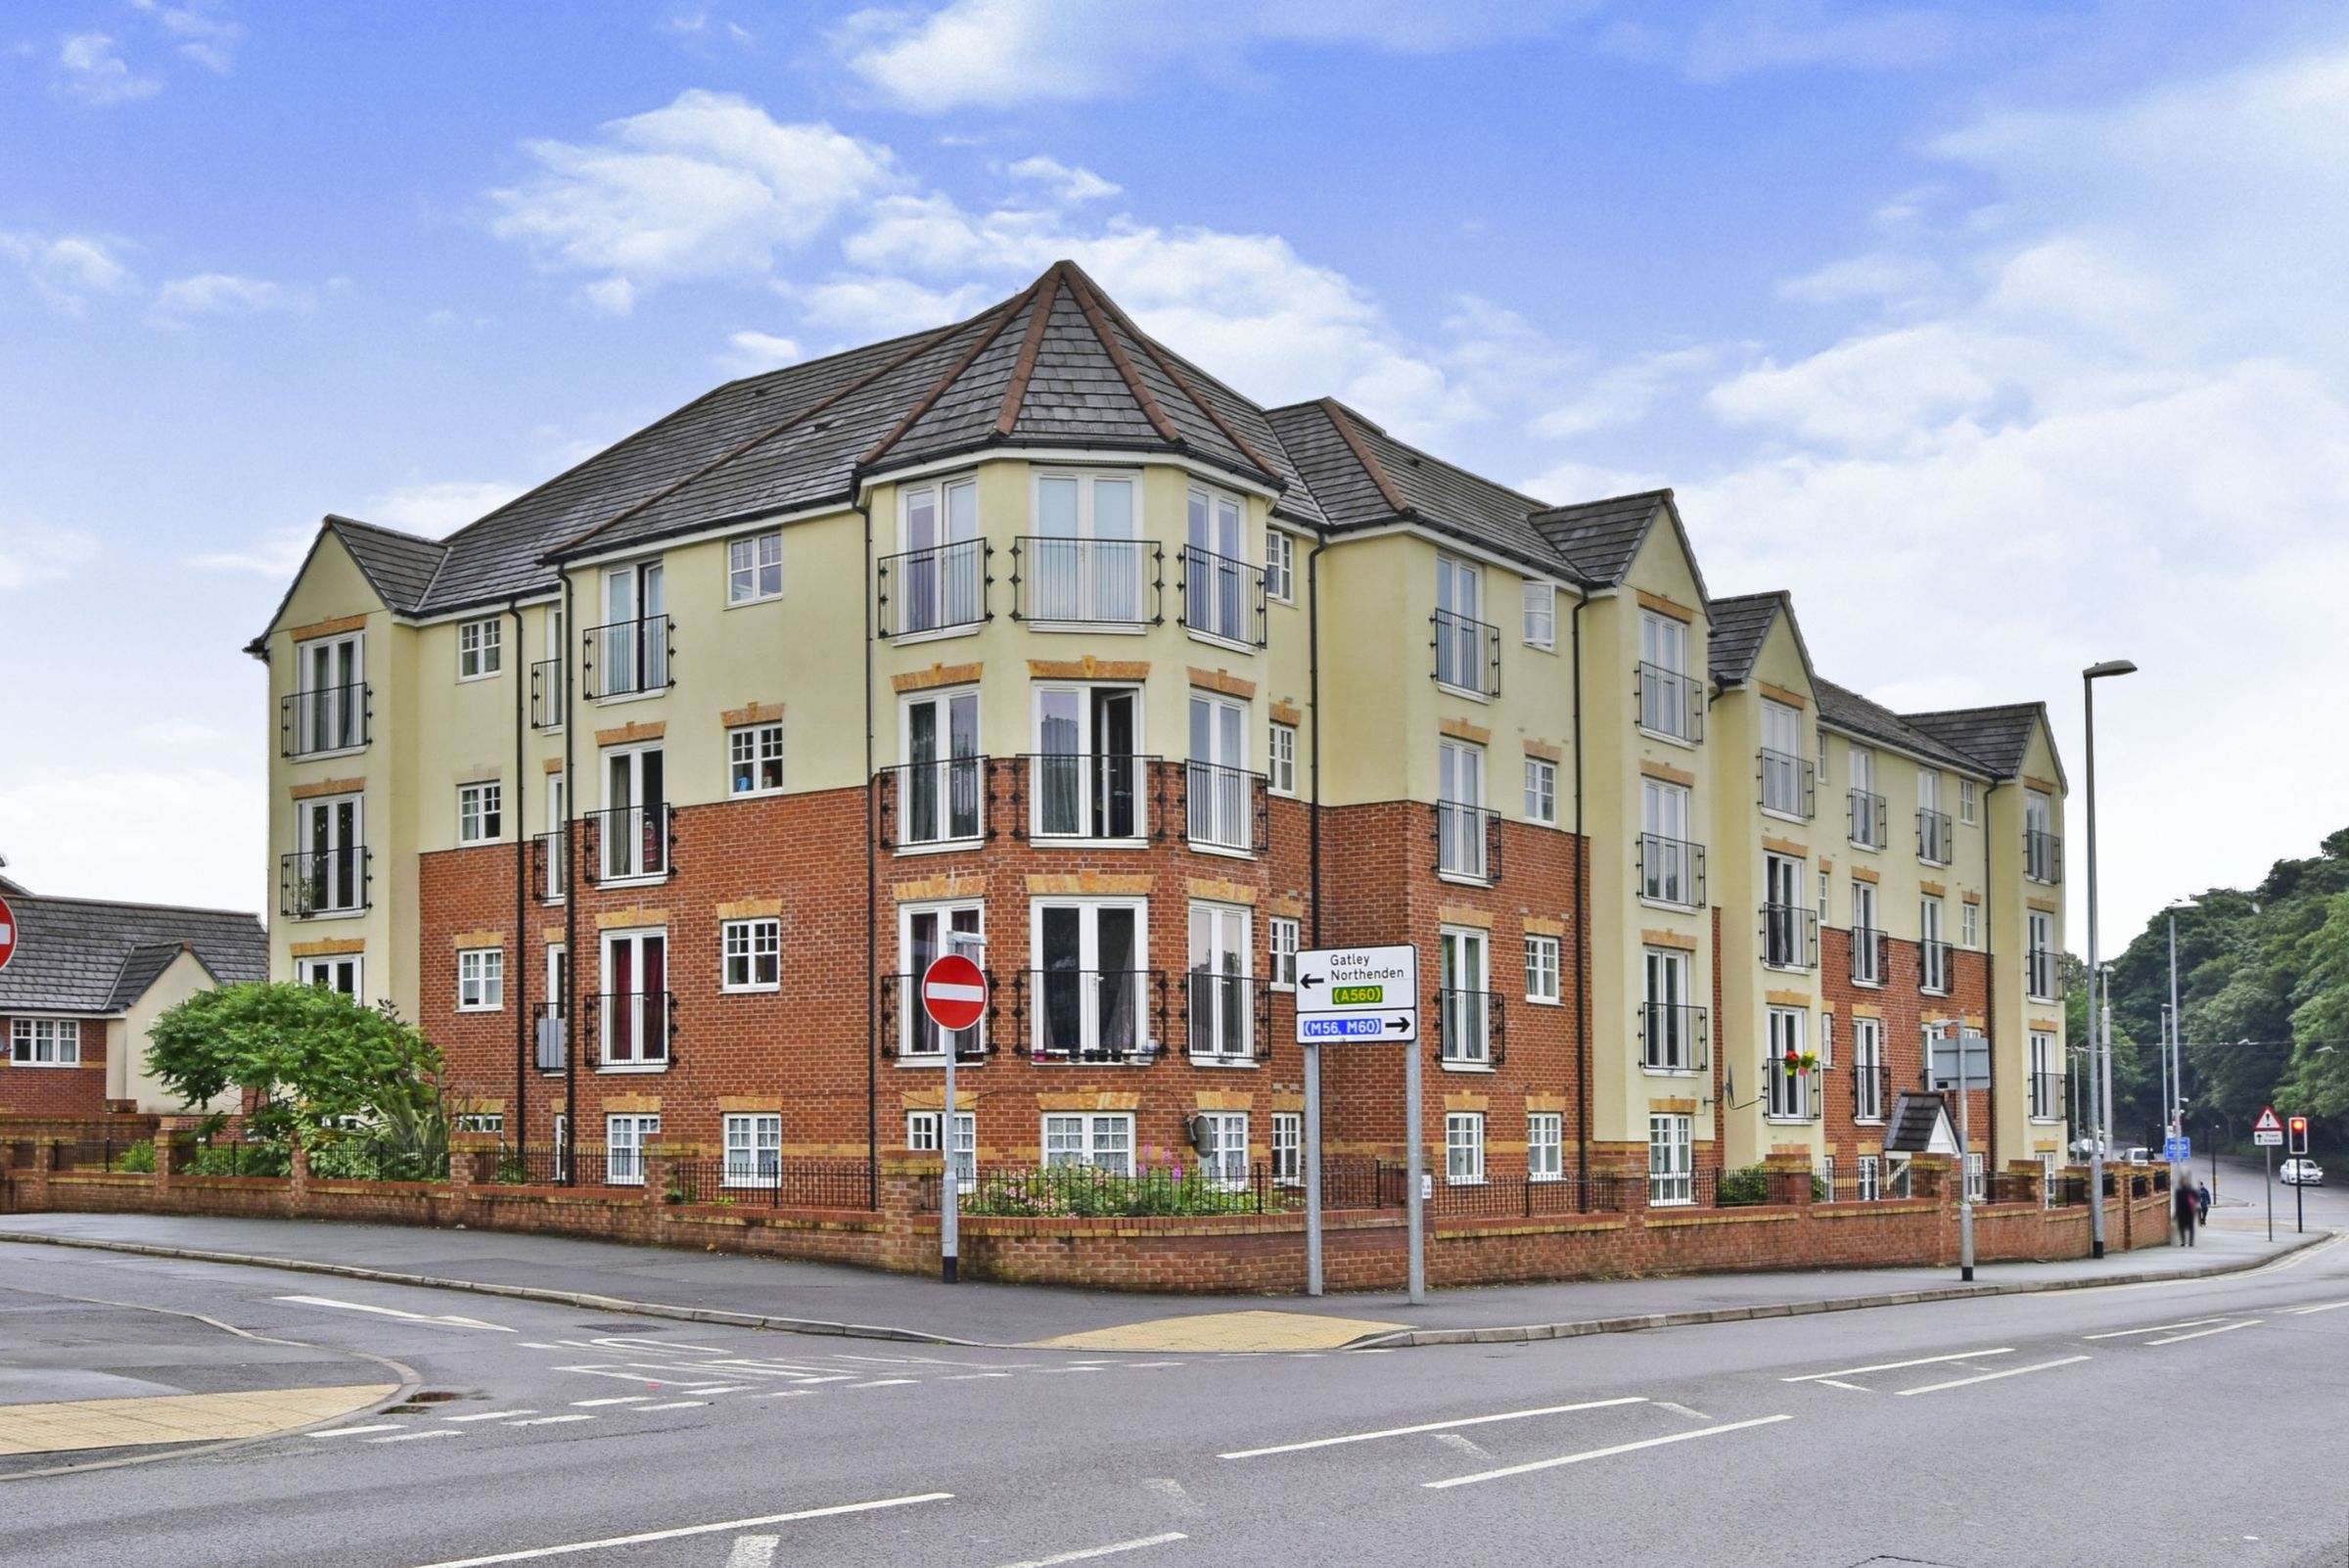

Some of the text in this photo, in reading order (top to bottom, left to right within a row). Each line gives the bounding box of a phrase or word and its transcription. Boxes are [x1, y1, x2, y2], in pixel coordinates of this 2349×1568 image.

[1330, 953, 1370, 967] Gatley
[1331, 967, 1405, 981] Northenden
[1334, 987, 1381, 1003] (A560)
[1347, 1019, 1381, 1034] M60)
